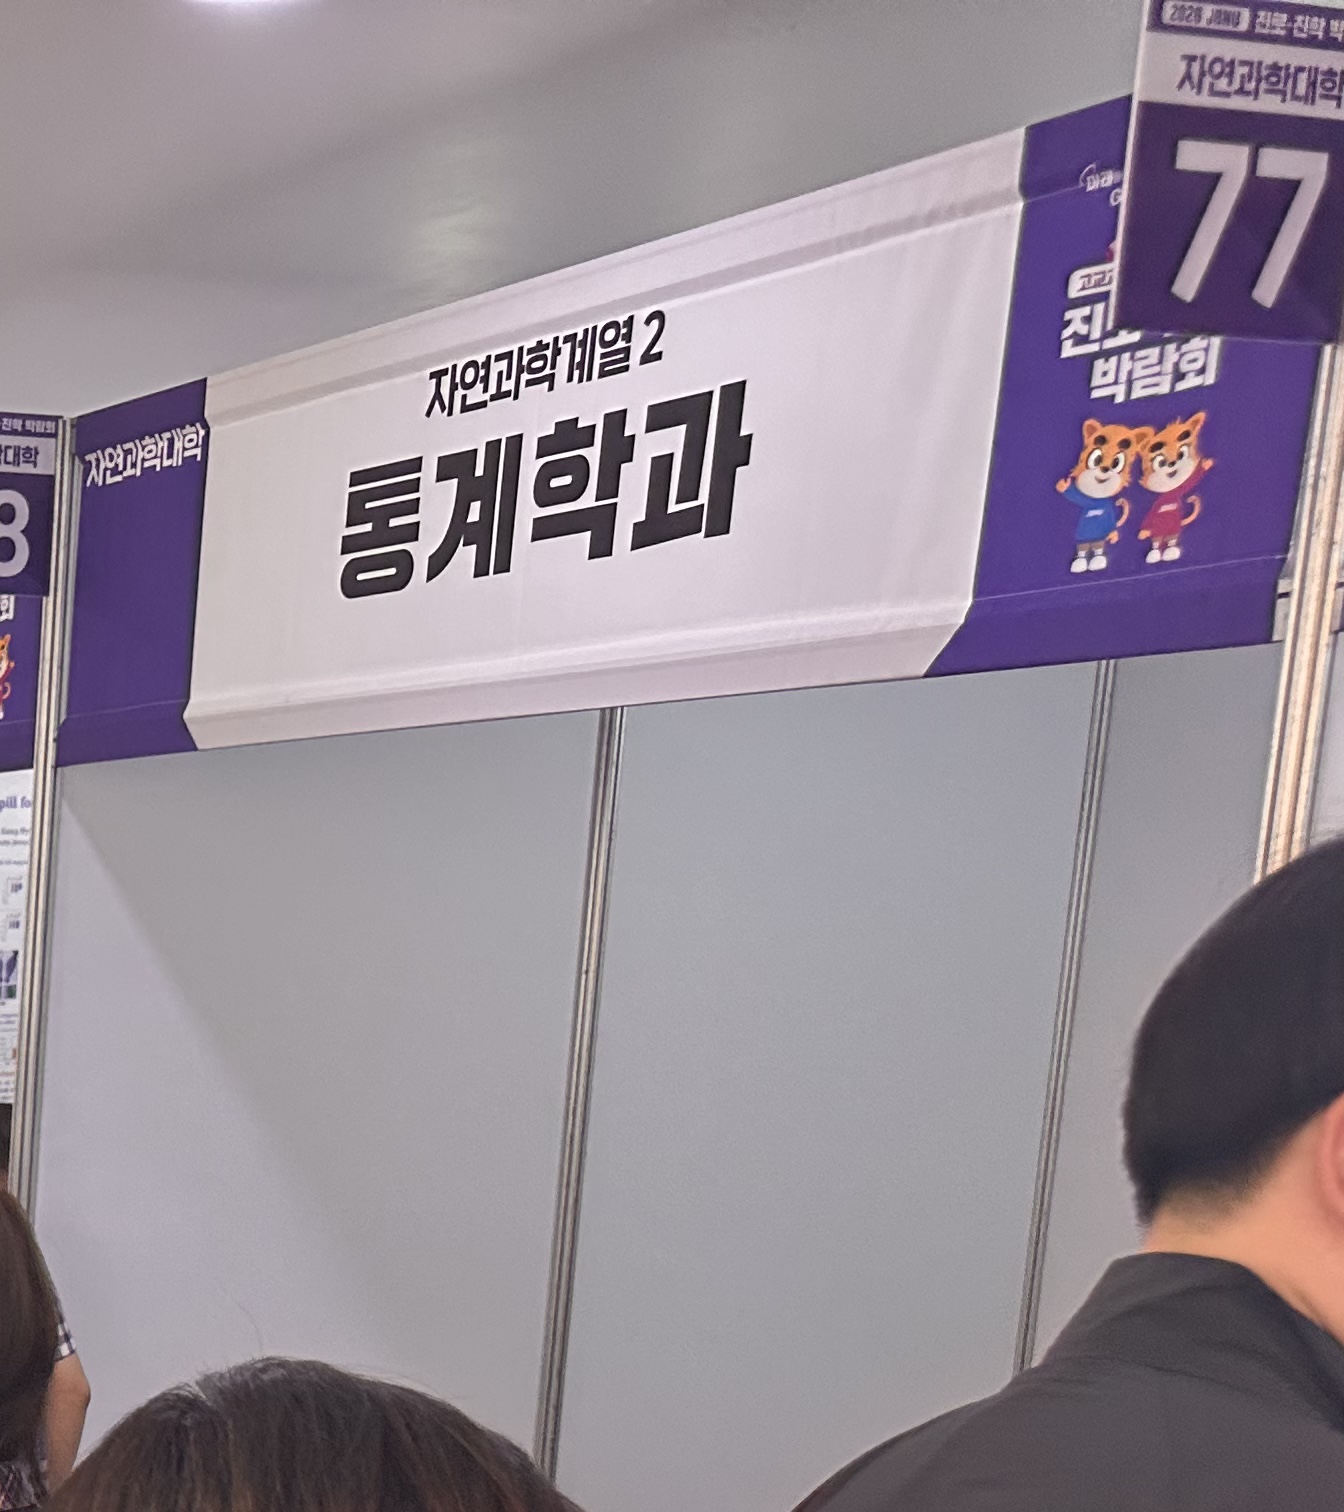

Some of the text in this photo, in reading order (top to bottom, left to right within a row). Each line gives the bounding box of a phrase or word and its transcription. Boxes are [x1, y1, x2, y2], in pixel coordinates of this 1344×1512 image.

[1176, 54, 1344, 109] 자연과학대학
[1171, 139, 1330, 309] 77
[425, 309, 667, 420] 자연과학계열 2
[1090, 336, 1223, 404] 박람회
[85, 422, 206, 487] 자연과학대학
[340, 379, 753, 600] 통계학과
